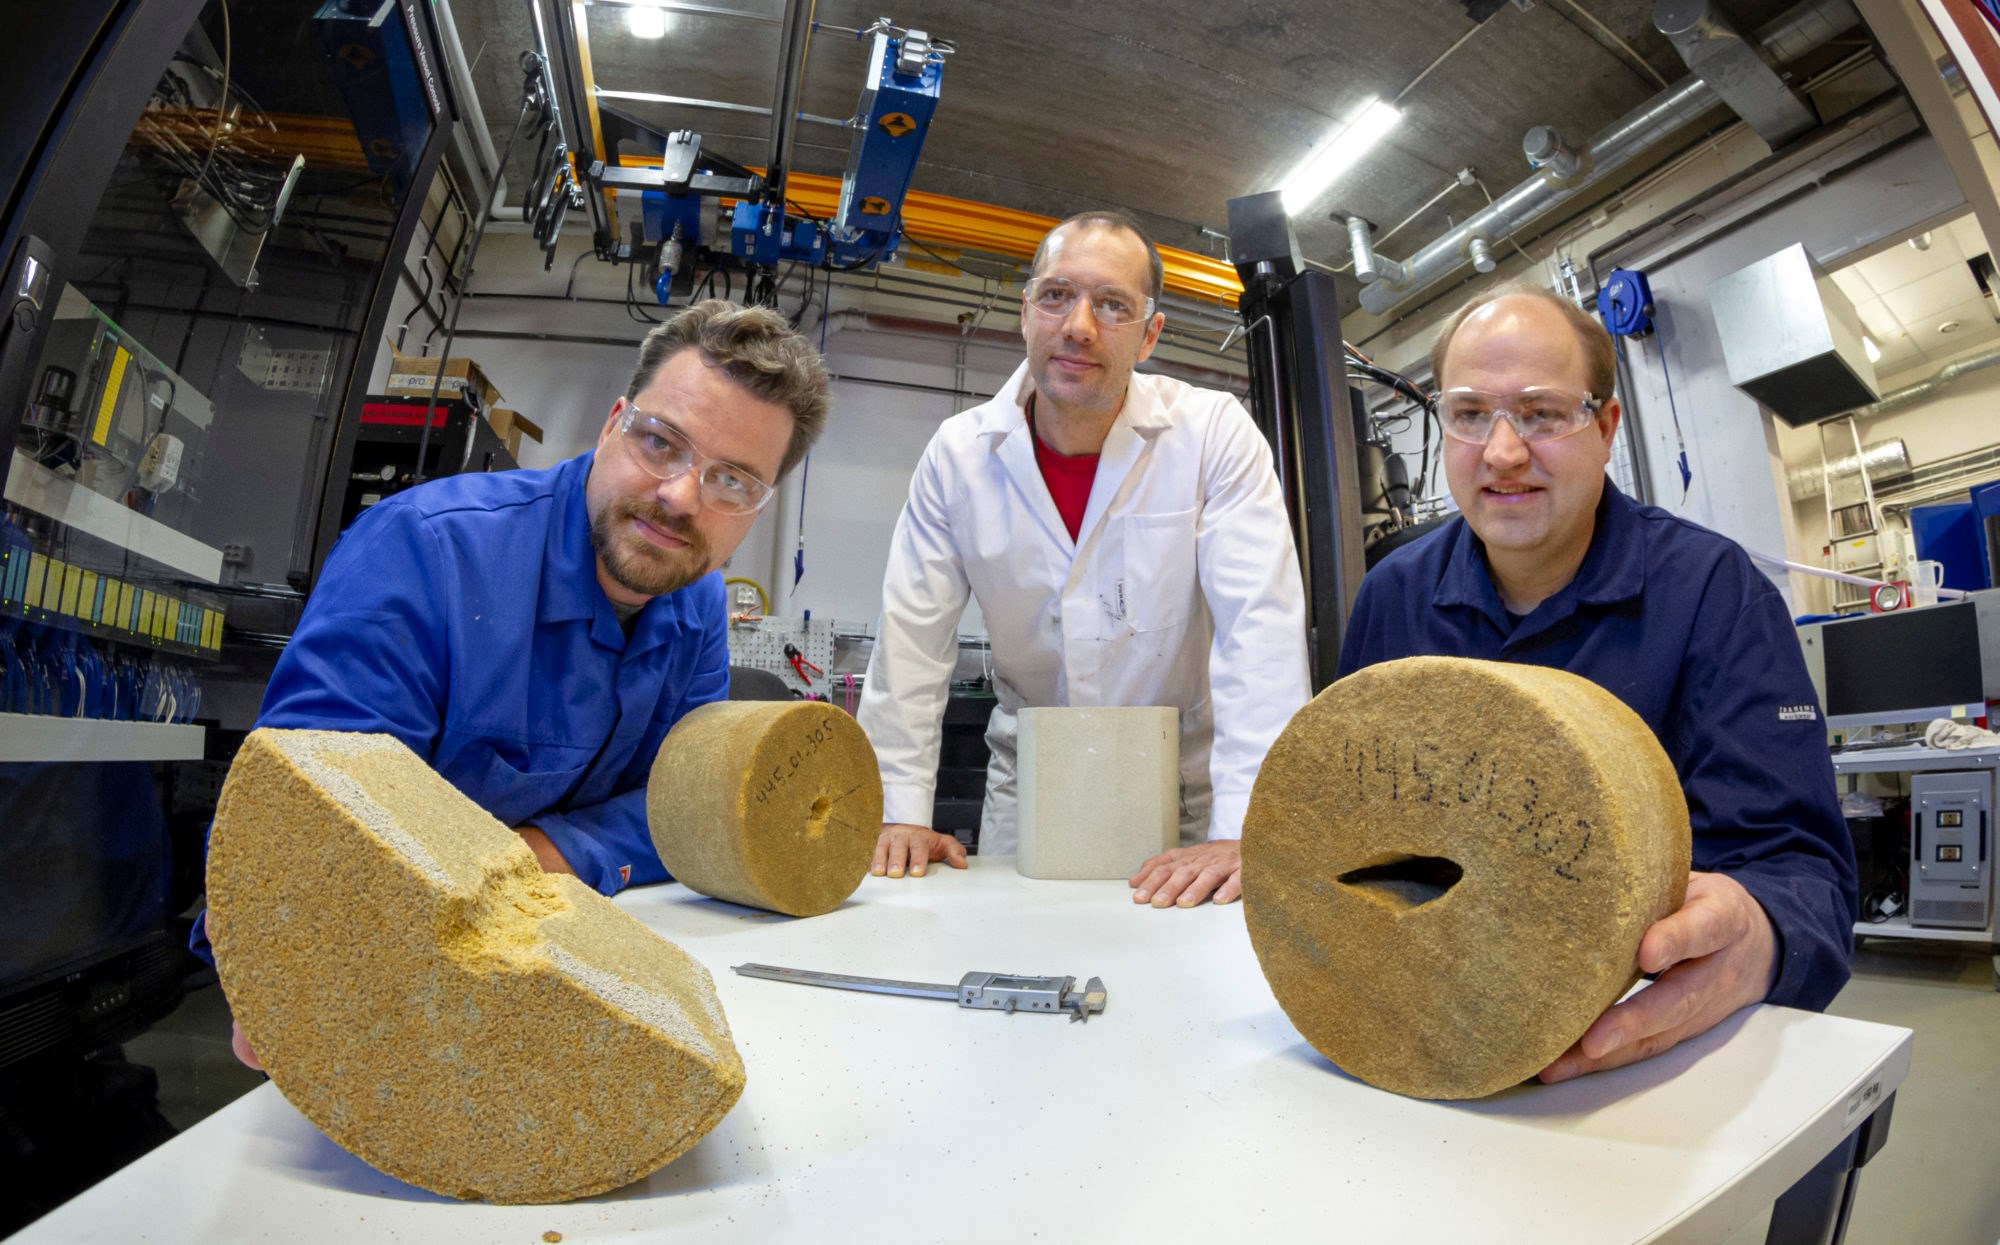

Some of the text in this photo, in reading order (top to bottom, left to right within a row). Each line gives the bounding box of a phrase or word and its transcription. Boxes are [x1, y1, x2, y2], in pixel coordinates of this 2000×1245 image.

[408, 5, 440, 114] Pressure Vessel Console
